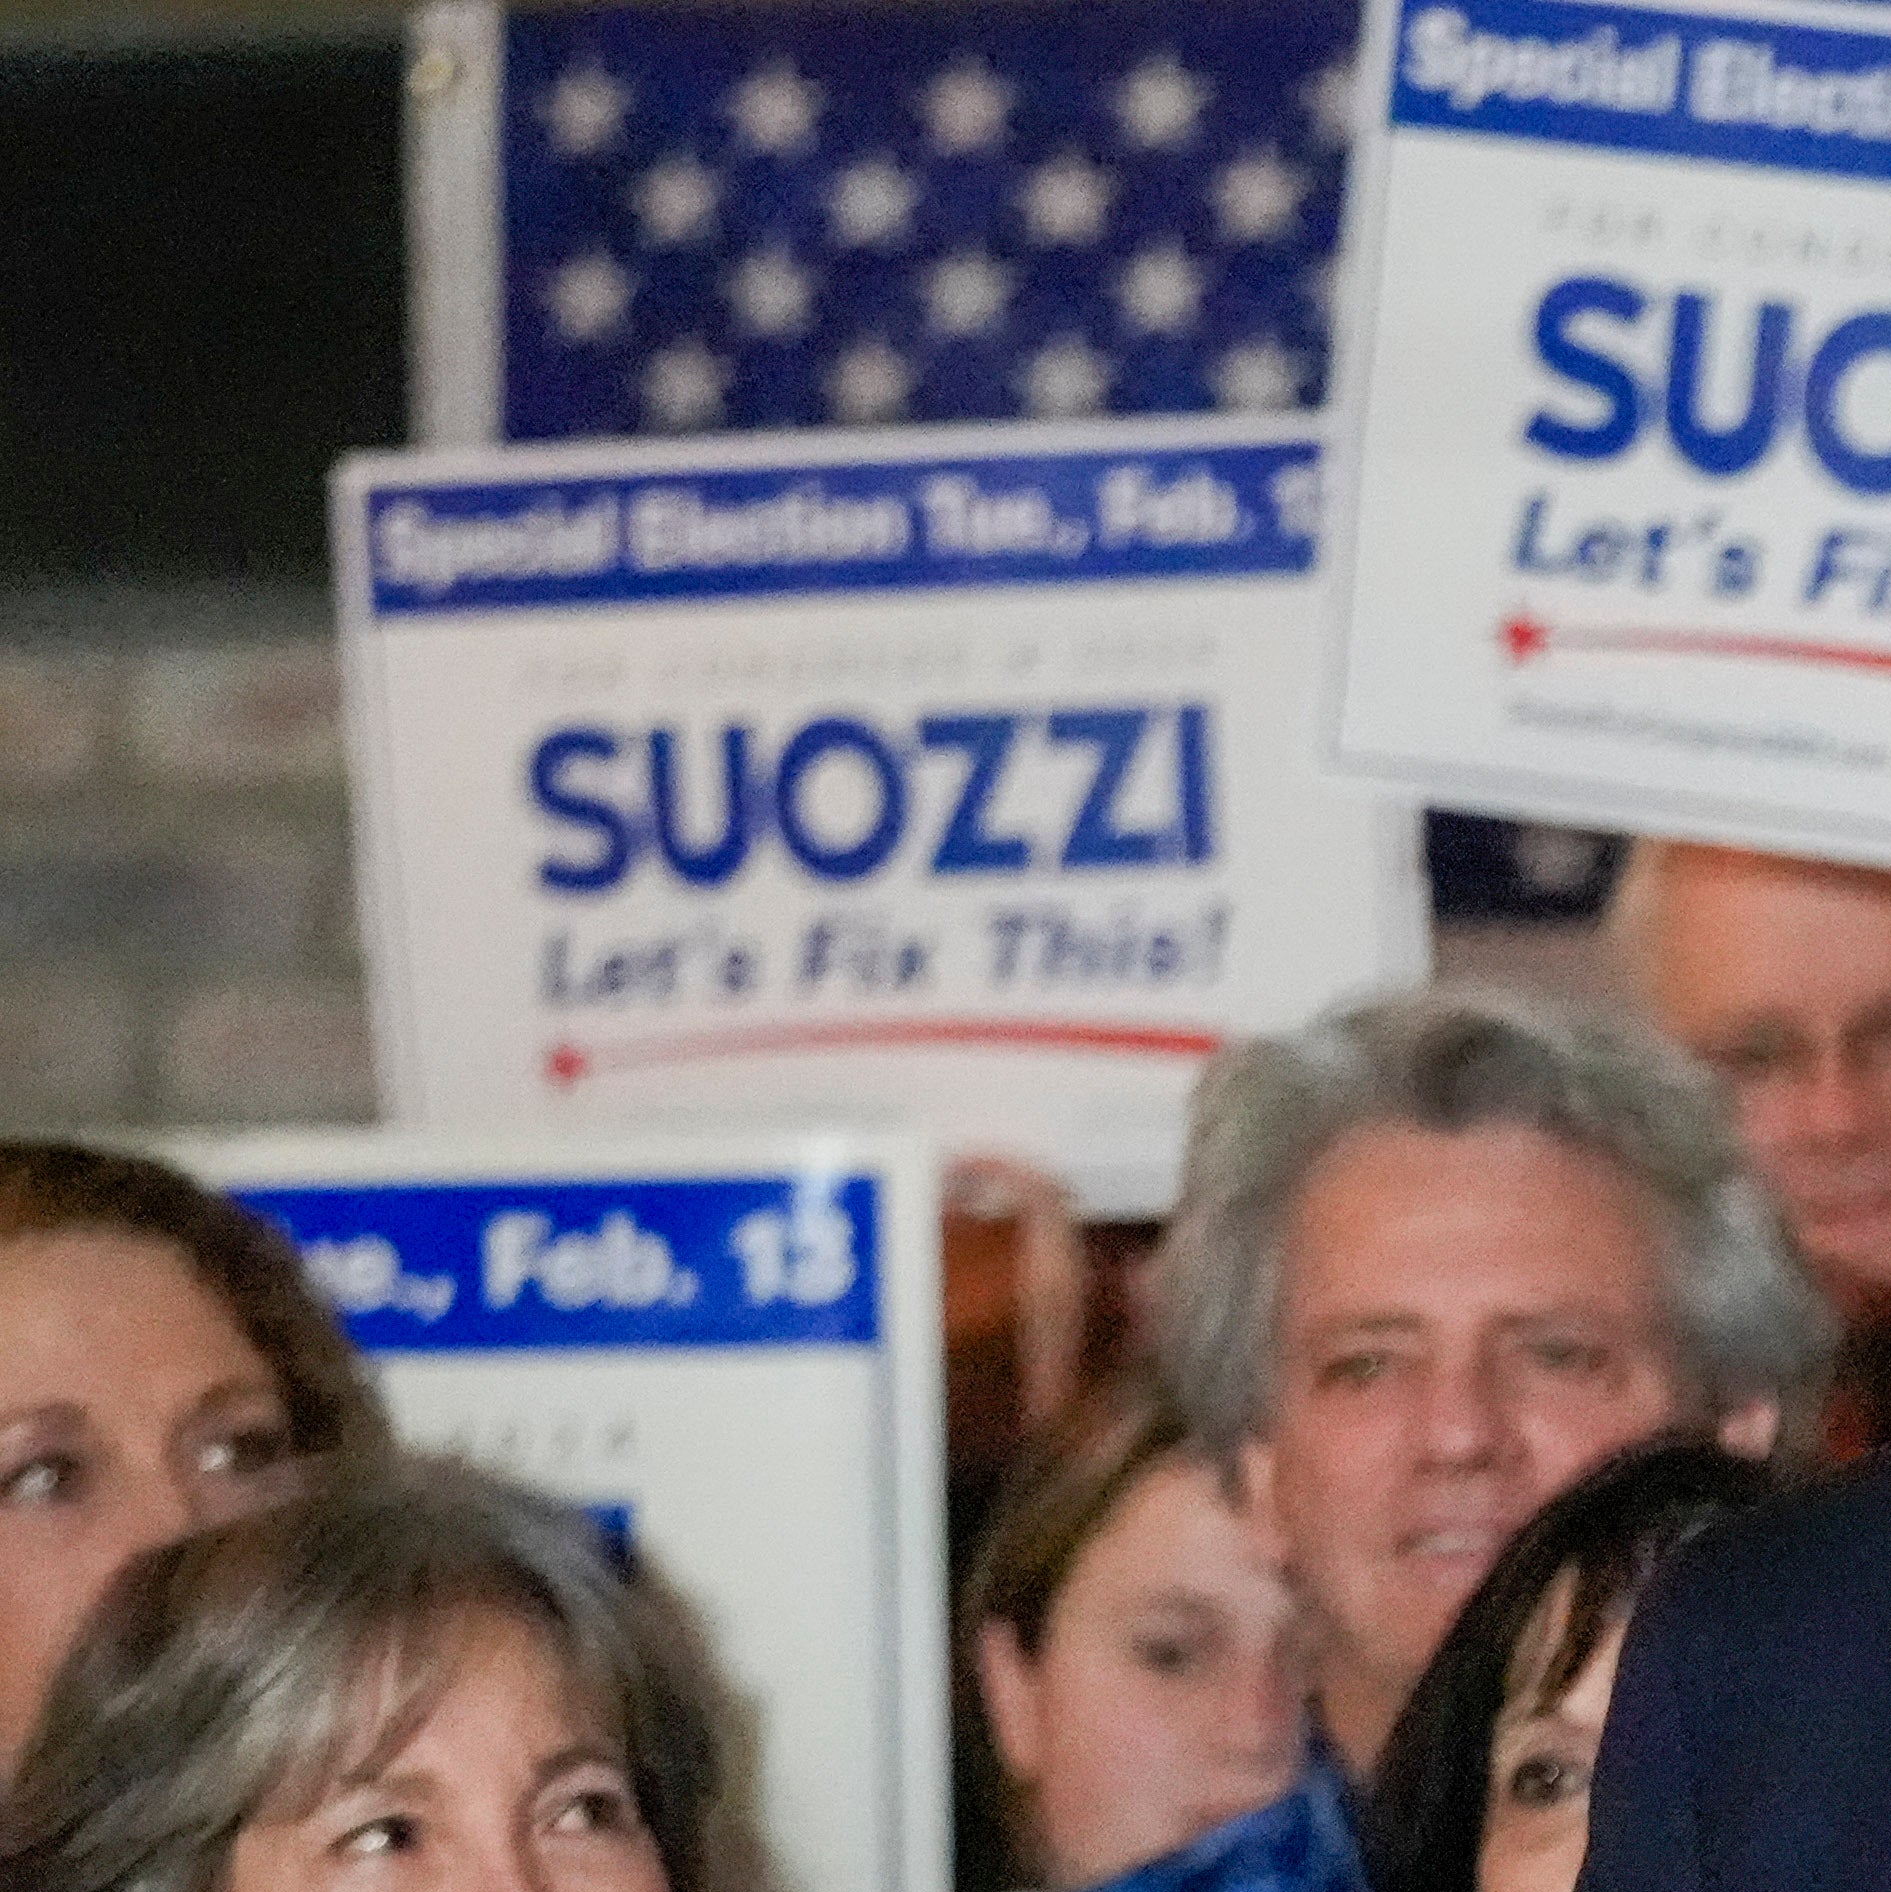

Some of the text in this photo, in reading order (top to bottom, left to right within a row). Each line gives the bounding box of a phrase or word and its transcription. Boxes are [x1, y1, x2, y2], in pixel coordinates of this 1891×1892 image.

[1401, 11, 1672, 115] Special
[1514, 492, 1760, 599] Let's
[529, 703, 1212, 894] SUOZZI
